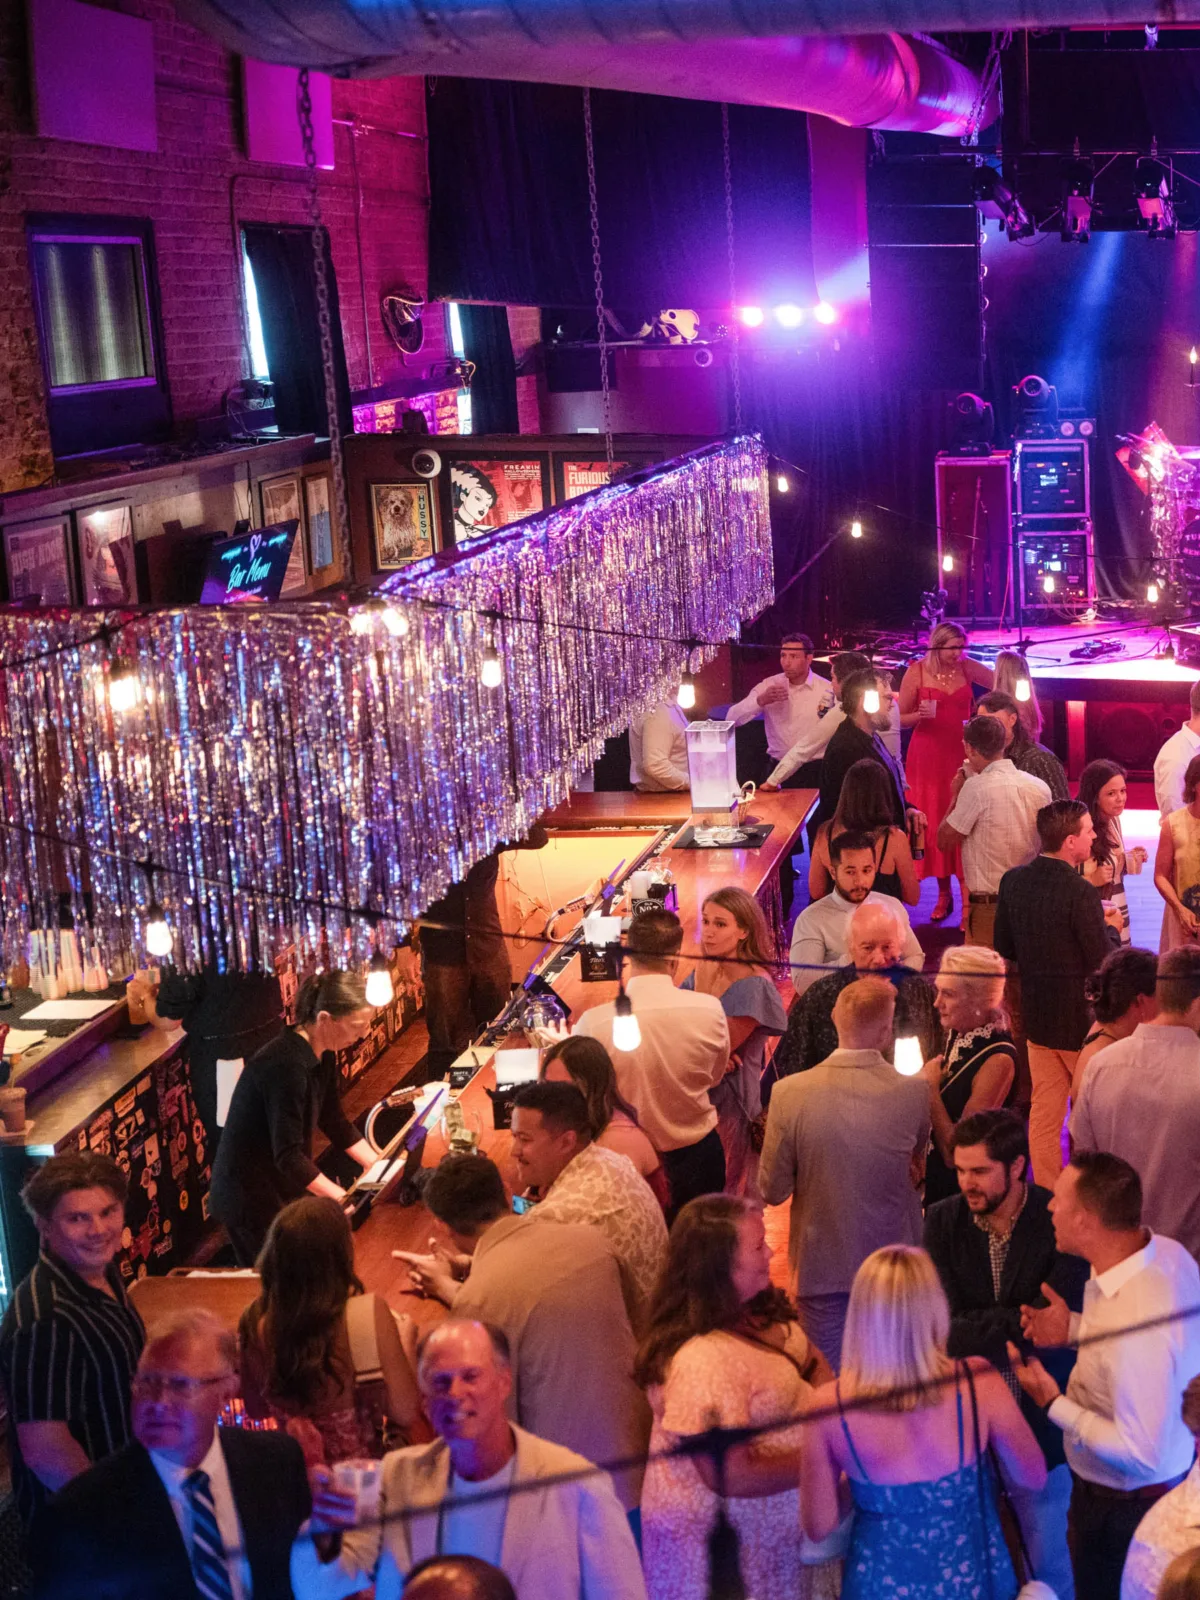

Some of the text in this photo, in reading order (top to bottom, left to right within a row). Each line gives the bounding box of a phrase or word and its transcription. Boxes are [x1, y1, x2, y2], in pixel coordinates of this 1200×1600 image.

[569, 472, 611, 484] FURIOUS
[418, 495, 427, 537] HUSSY
[226, 557, 271, 594] Bar Menu
